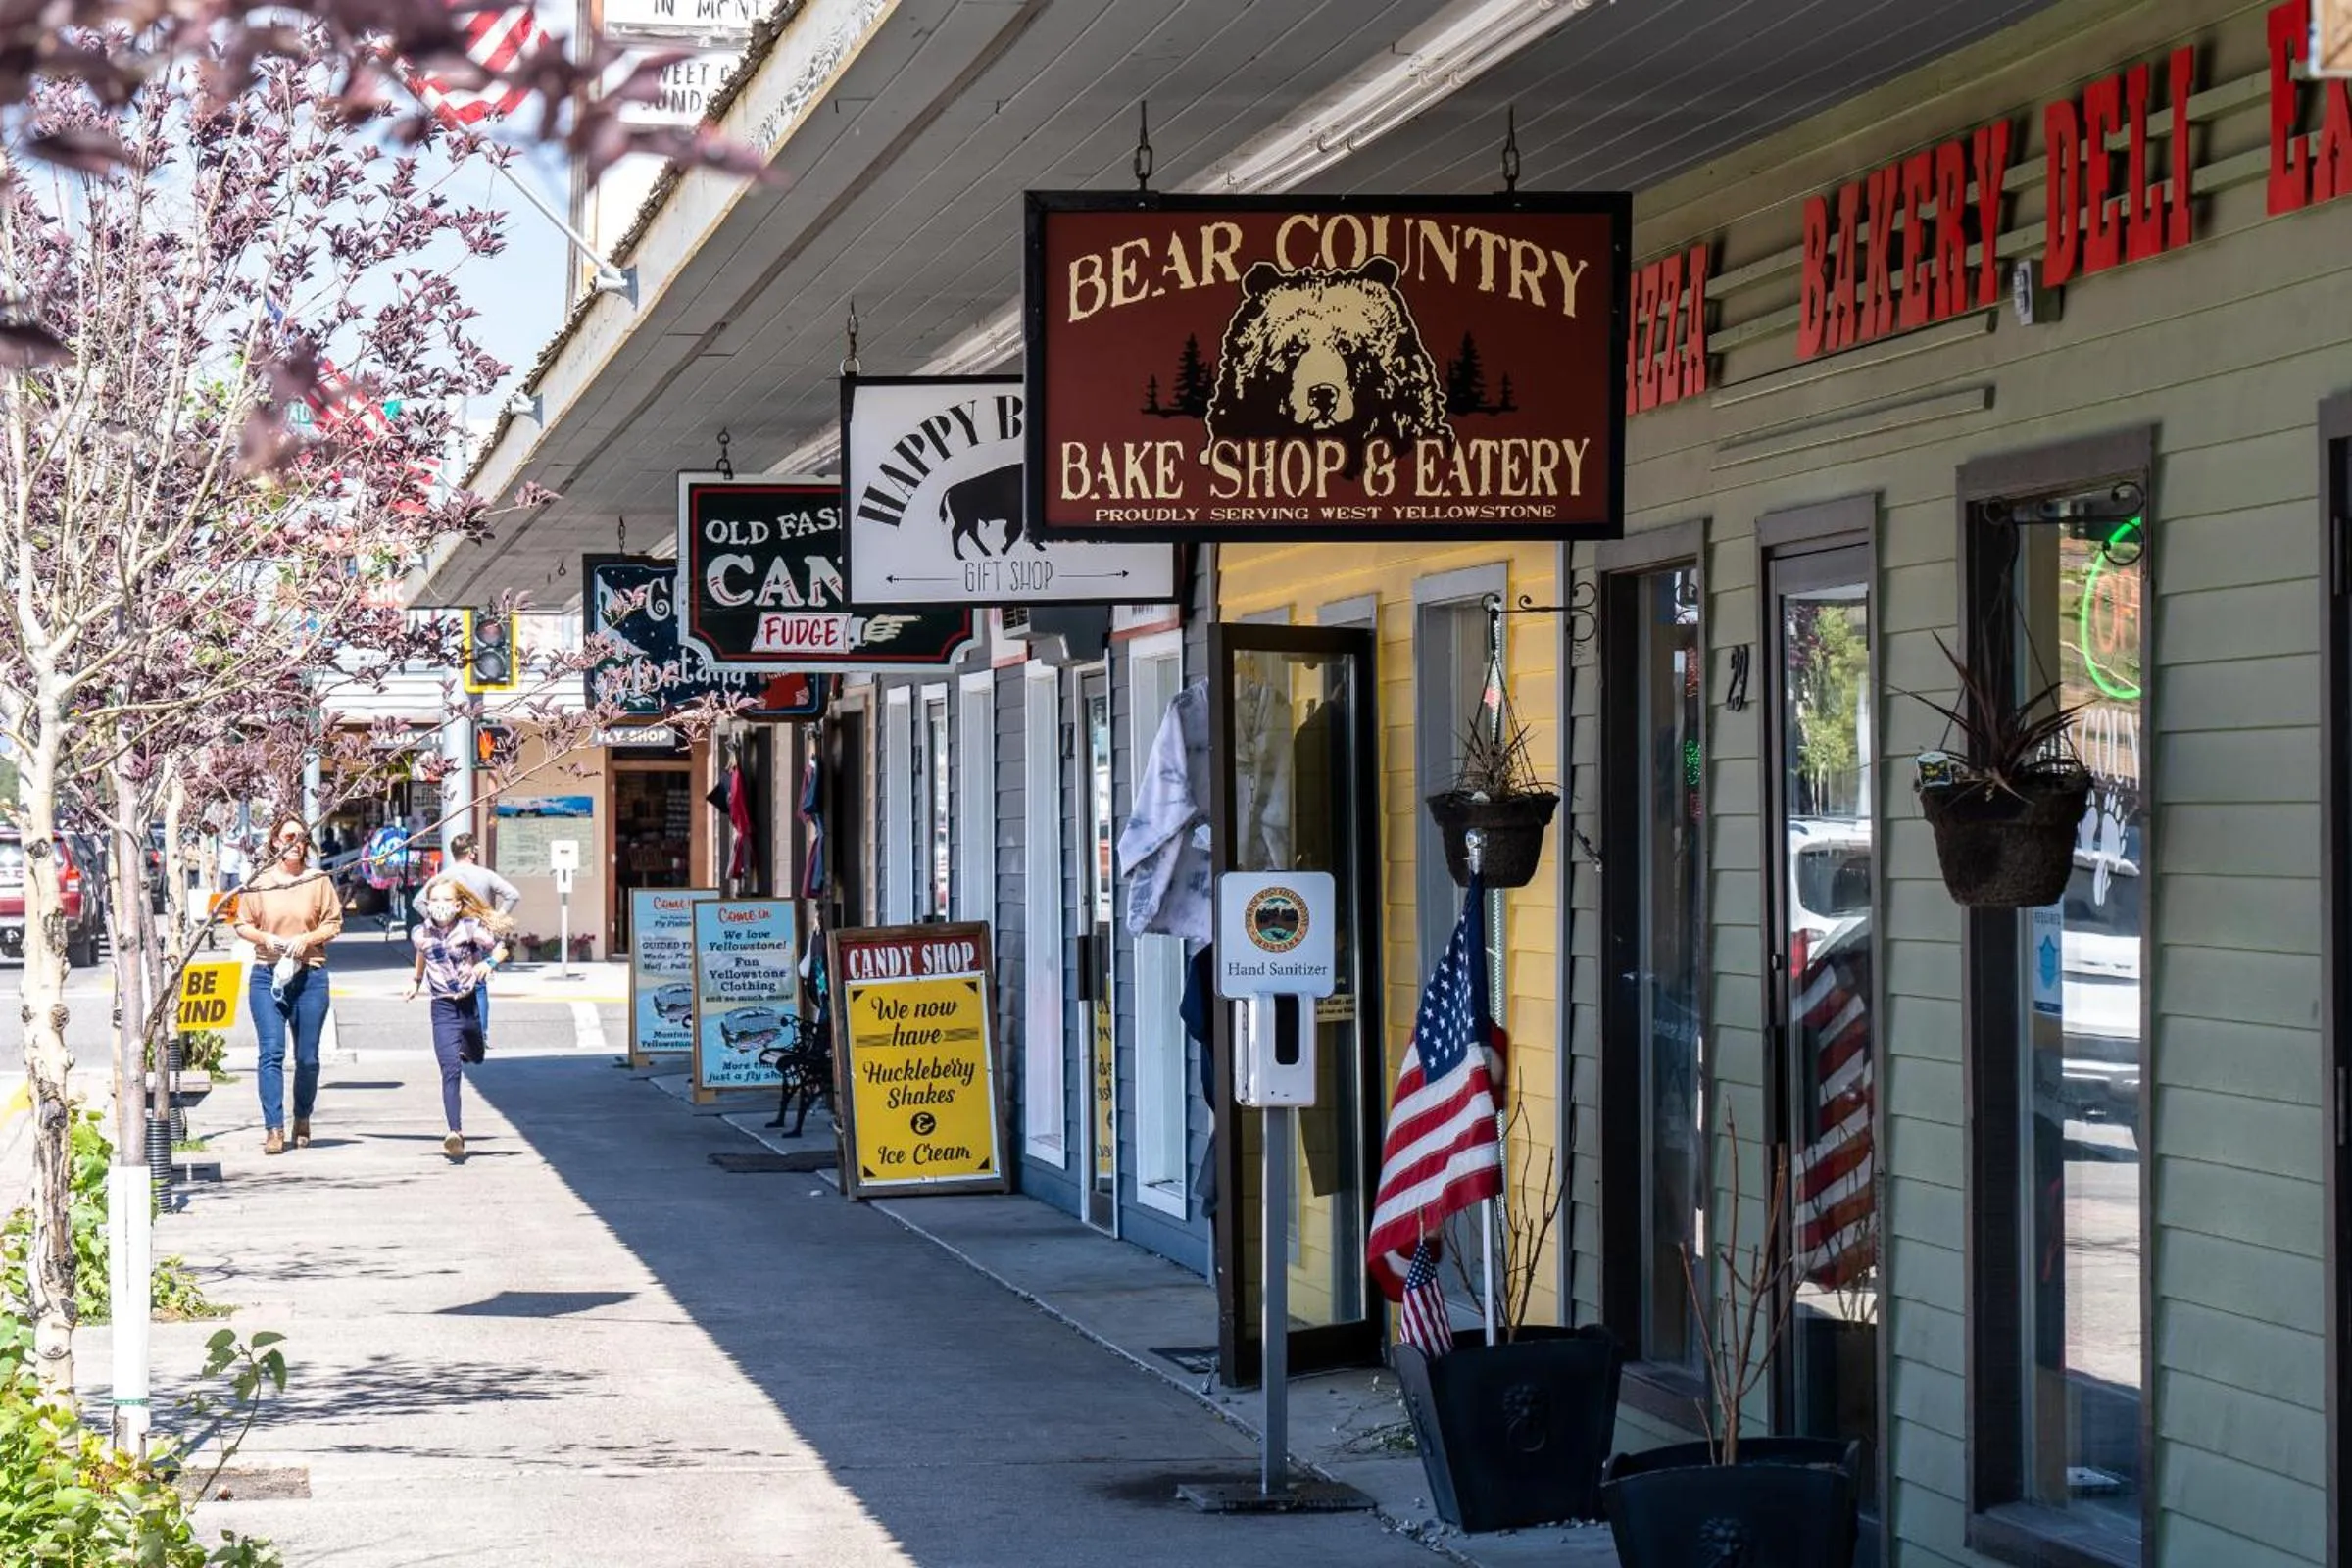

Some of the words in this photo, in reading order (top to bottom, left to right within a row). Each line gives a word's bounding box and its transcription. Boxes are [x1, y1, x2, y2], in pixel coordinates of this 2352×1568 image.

[1796, 119, 2011, 359] BAKERY
[2042, 45, 2193, 288] DELI
[1067, 221, 1243, 322] BEAR
[1276, 214, 1588, 318] COUNTRY
[857, 399, 982, 530] HAPPY
[1061, 441, 1184, 501] BAKE
[1210, 440, 1348, 498] SHOP
[1363, 441, 1396, 497] &
[1415, 438, 1591, 497] EATERY
[1095, 507, 1200, 521] PROUDLY
[1210, 507, 1309, 521] SERVING
[1320, 506, 1382, 520] WEST
[1392, 504, 1556, 520] YELLOWSTONE
[705, 519, 769, 545] OLD
[965, 562, 1001, 592] GIFT
[1010, 561, 1054, 592] SHOP
[764, 616, 839, 647] FUDGE
[628, 730, 668, 742] SHOP
[718, 906, 755, 924] Come
[642, 941, 680, 950] GUIDED
[723, 930, 742, 940] We
[747, 929, 771, 939] love
[709, 940, 787, 952] Yellowstone!
[734, 957, 760, 967] Fun
[849, 946, 913, 979] CANDY
[921, 942, 975, 974] SHOP
[1228, 962, 1265, 976] Hand
[1269, 962, 1328, 976] Sanitizer
[186, 970, 218, 996] BE
[709, 969, 787, 980] Yellowstone
[720, 980, 777, 993] Clothing
[871, 997, 909, 1020] We
[914, 1001, 957, 1019] now
[892, 1023, 942, 1047] have
[708, 1072, 730, 1083] just
[745, 1070, 761, 1082] fly
[722, 1061, 751, 1071] More
[862, 1056, 975, 1086] Huckleberry
[887, 1082, 956, 1109] Shakes
[877, 1145, 906, 1165] Ice
[913, 1143, 972, 1165] Cream
